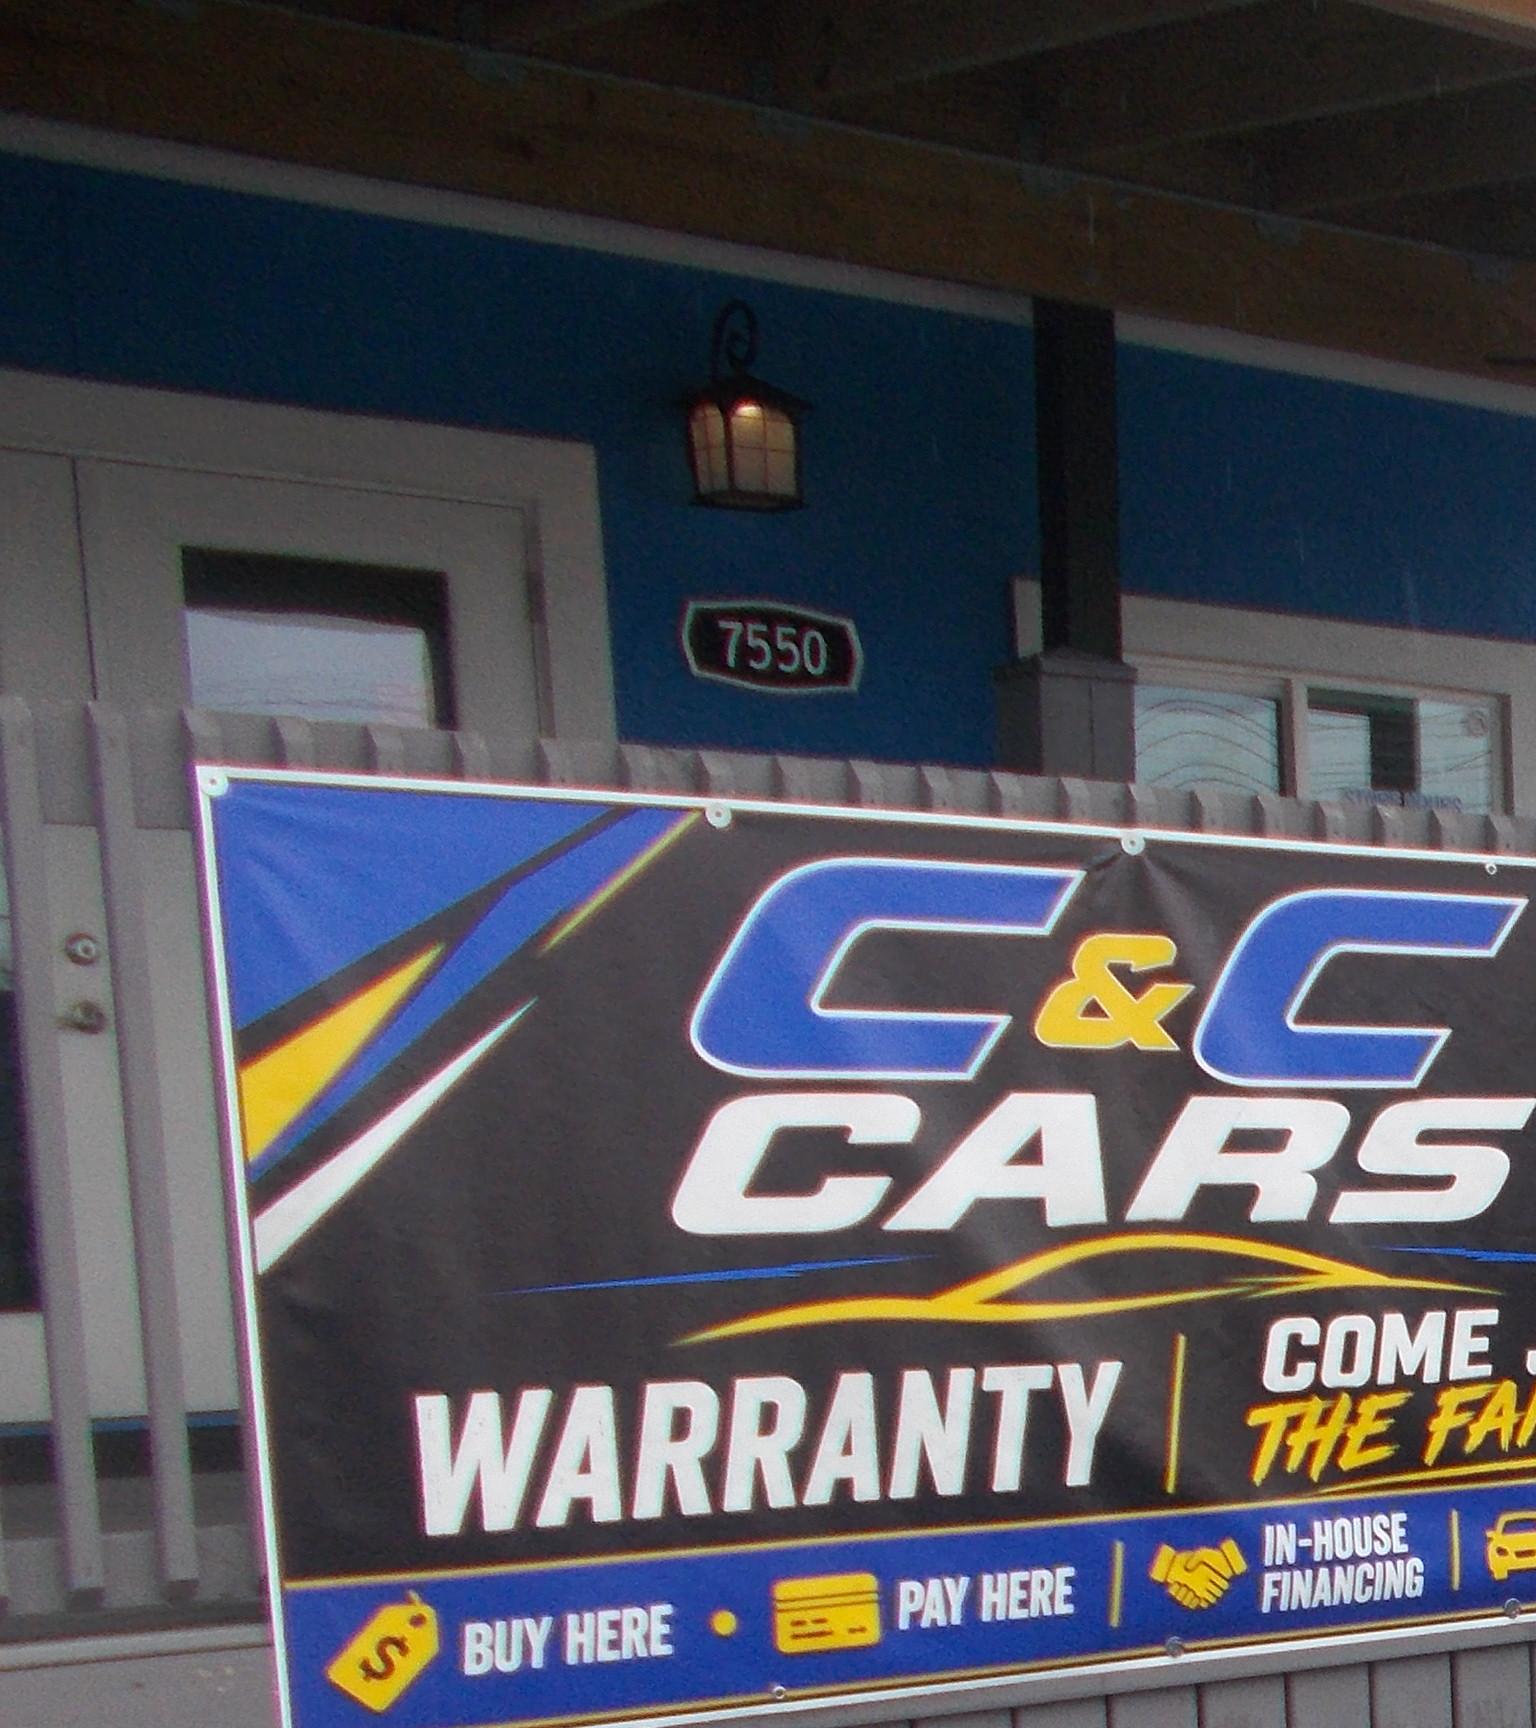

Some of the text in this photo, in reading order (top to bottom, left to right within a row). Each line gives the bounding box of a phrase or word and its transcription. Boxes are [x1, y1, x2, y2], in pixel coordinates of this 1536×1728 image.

[718, 620, 828, 676] 7550
[690, 856, 1528, 1089] C&C
[1262, 1308, 1501, 1393] COME
[413, 1359, 1123, 1538] WARRANTY
[1245, 1390, 1415, 1487] THE
[1263, 1511, 1410, 1568] IN-HOUSE
[897, 1566, 1077, 1631] PAY HERE
[1261, 1556, 1426, 1614] FINANCING
[462, 1603, 675, 1676] BUY HERE
